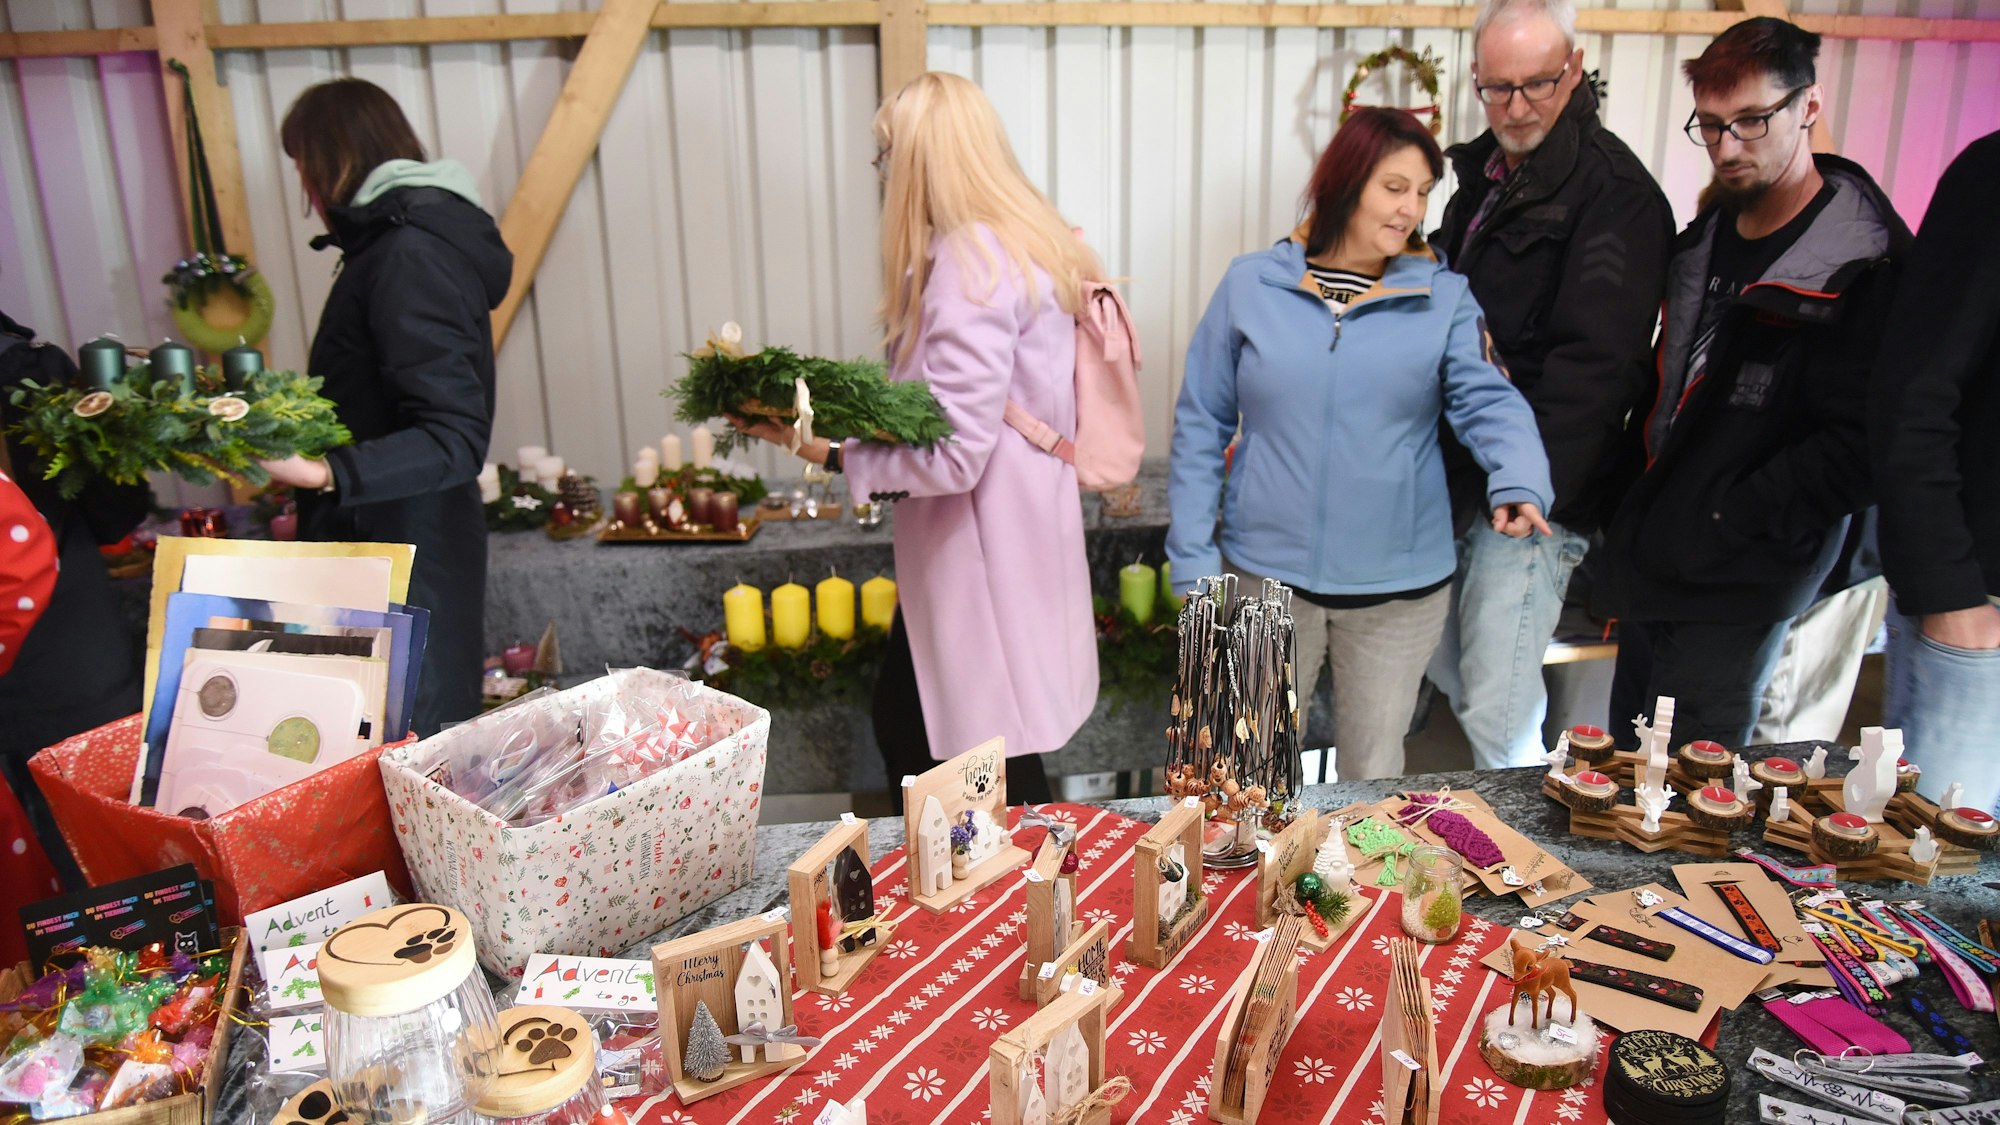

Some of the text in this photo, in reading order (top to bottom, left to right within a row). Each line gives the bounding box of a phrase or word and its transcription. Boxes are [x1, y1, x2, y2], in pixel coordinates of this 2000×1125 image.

[639, 829, 652, 880] WEIHNACHTEN
[653, 828, 667, 865] Frohe
[265, 897, 340, 940] Advent
[683, 954, 720, 970] Merry
[1078, 936, 1104, 973] HOME
[533, 958, 641, 984] Advent
[677, 969, 724, 988] Christmas
[595, 990, 638, 1006] to go
[1623, 1035, 1672, 1051] MERRY
[1653, 1072, 1725, 1095] CHRISTMAS
